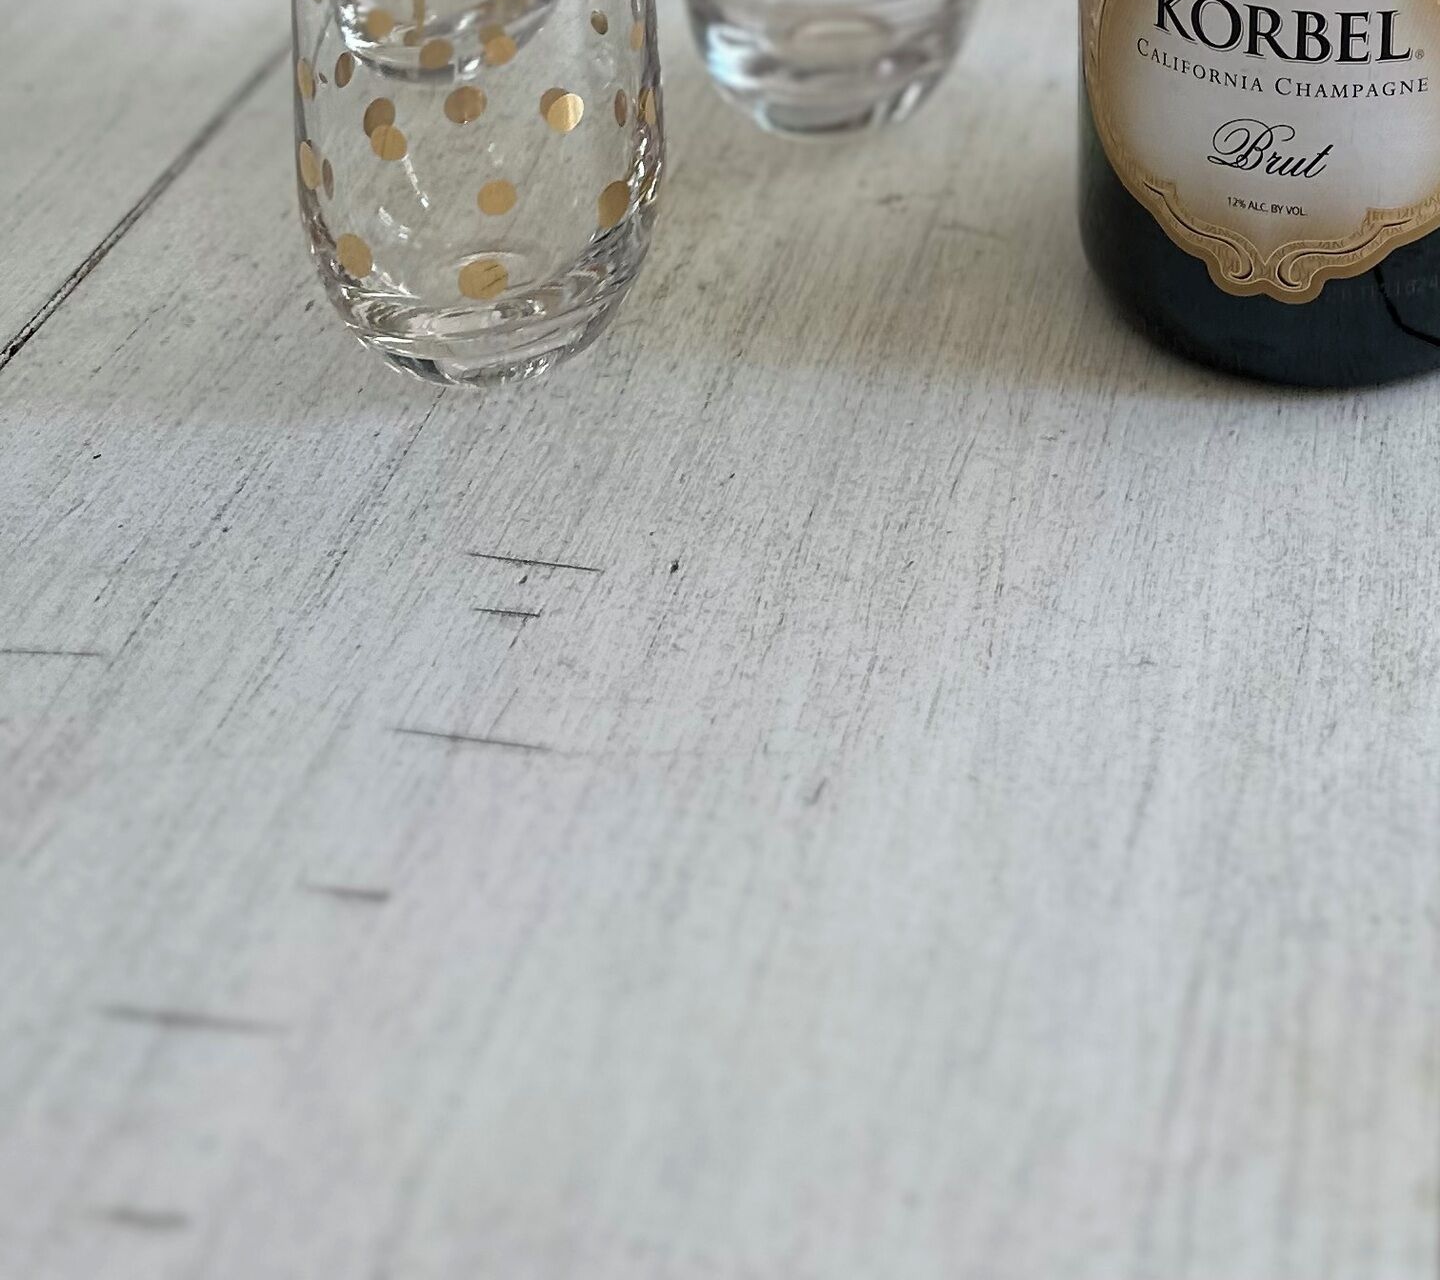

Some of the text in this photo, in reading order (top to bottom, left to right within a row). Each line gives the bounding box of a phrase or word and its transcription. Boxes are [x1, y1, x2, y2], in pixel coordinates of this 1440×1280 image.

[1137, 37, 1429, 99] CALIFORNIA CHAMPAGNE
[1207, 118, 1334, 178] Brut
[1227, 196, 1246, 209] 12%
[1270, 203, 1284, 214] BY
